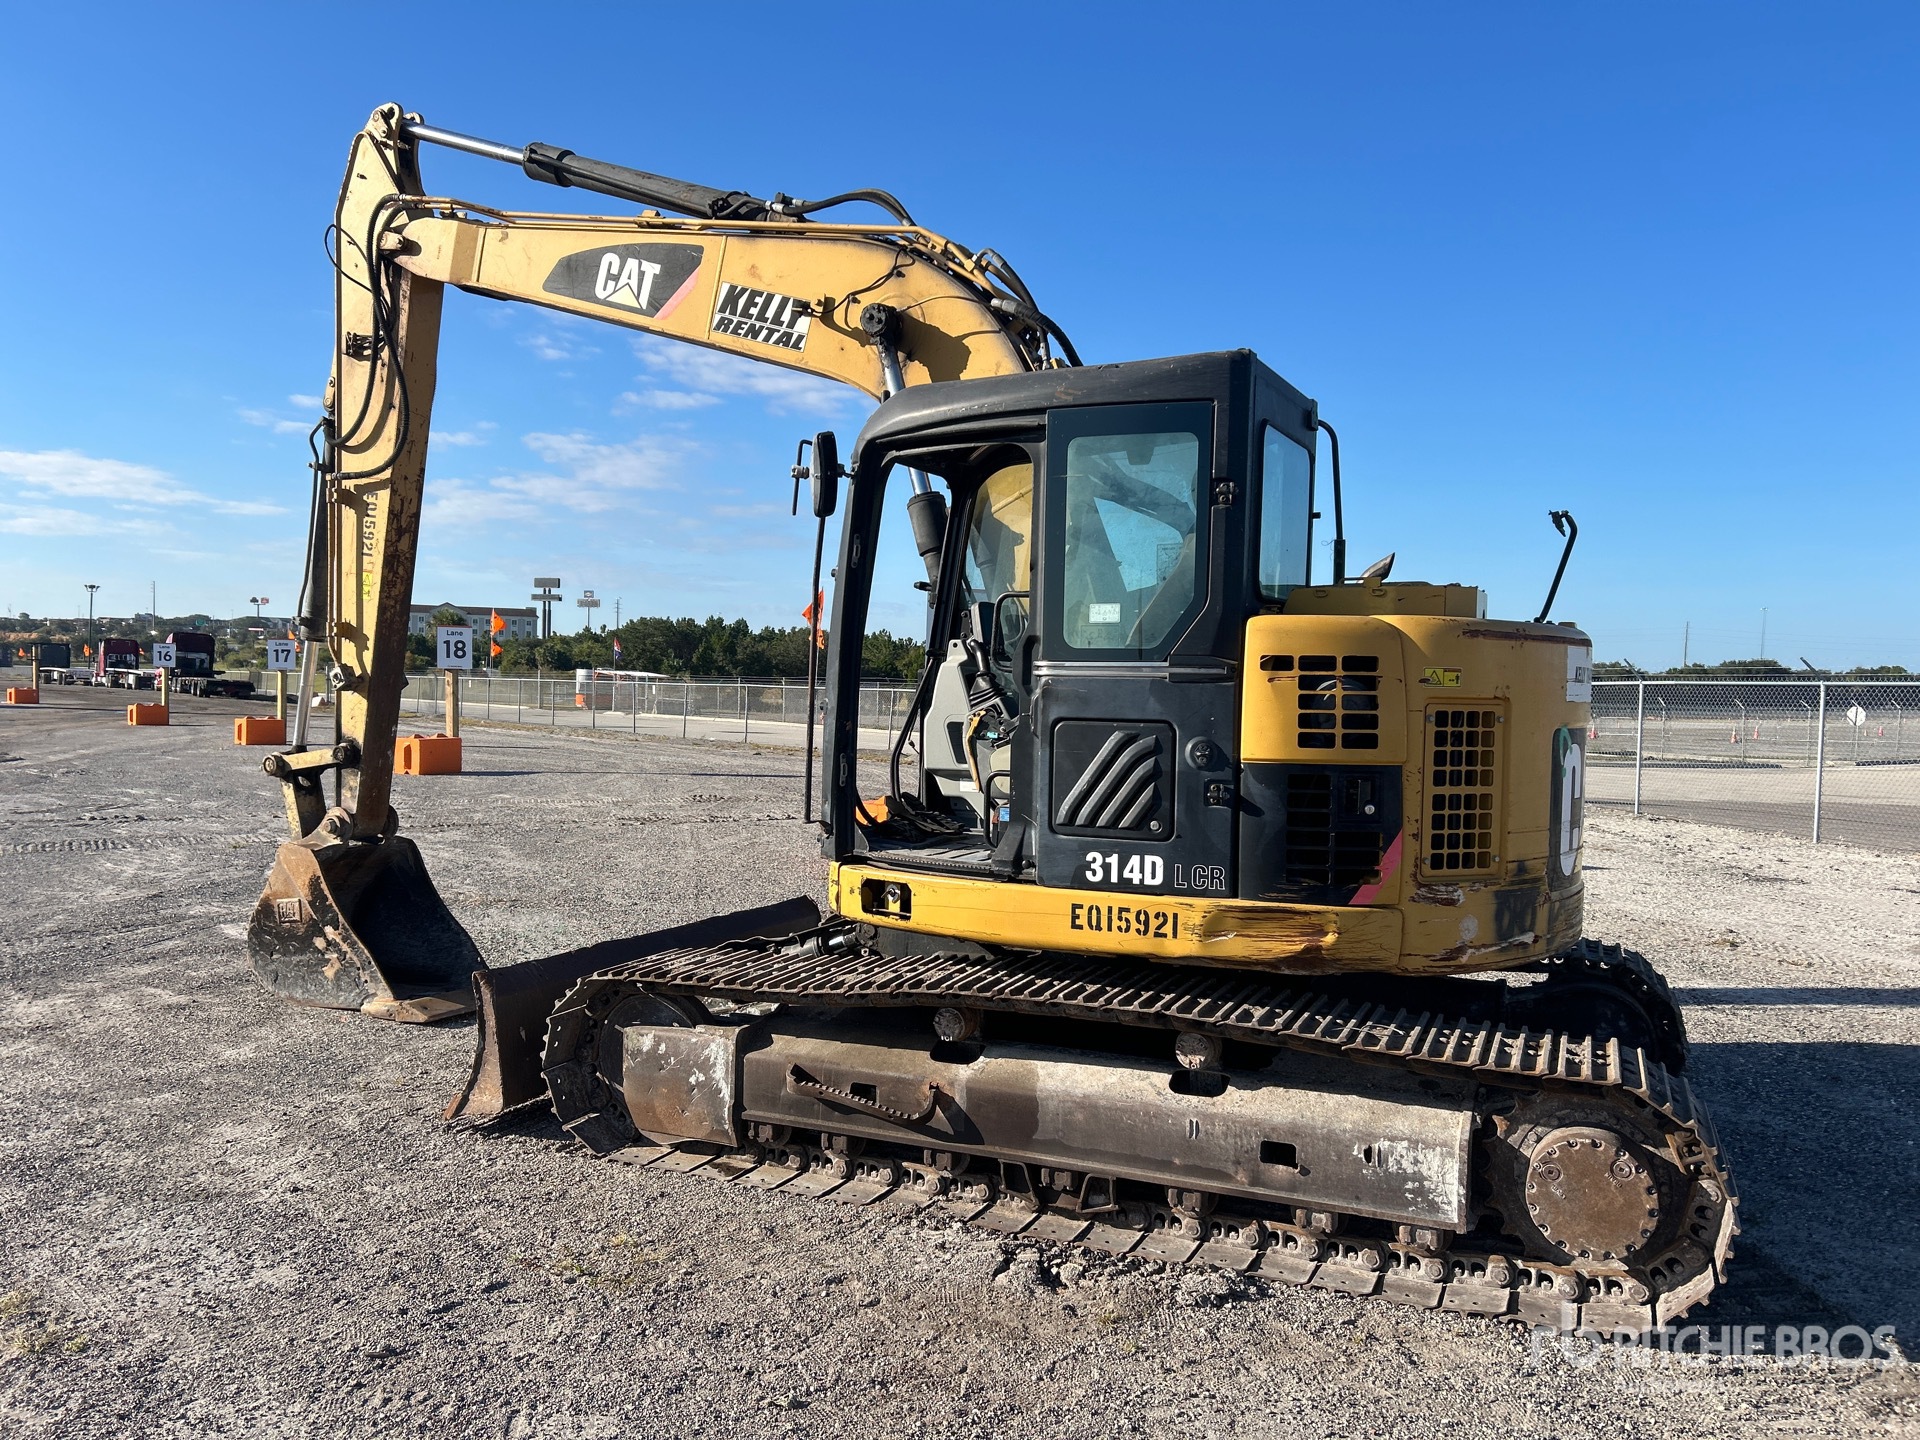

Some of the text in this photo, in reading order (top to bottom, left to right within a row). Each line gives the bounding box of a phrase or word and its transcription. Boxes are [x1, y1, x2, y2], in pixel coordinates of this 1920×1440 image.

[594, 252, 662, 310] CAT
[717, 284, 809, 331] KELLY
[713, 315, 806, 351] RENTAL
[443, 639, 467, 659] 18
[446, 629, 464, 637] Lane
[157, 650, 173, 662] 16
[273, 648, 291, 663] 17
[1085, 851, 1164, 886] 314D
[1070, 903, 1179, 939] EQ15921
